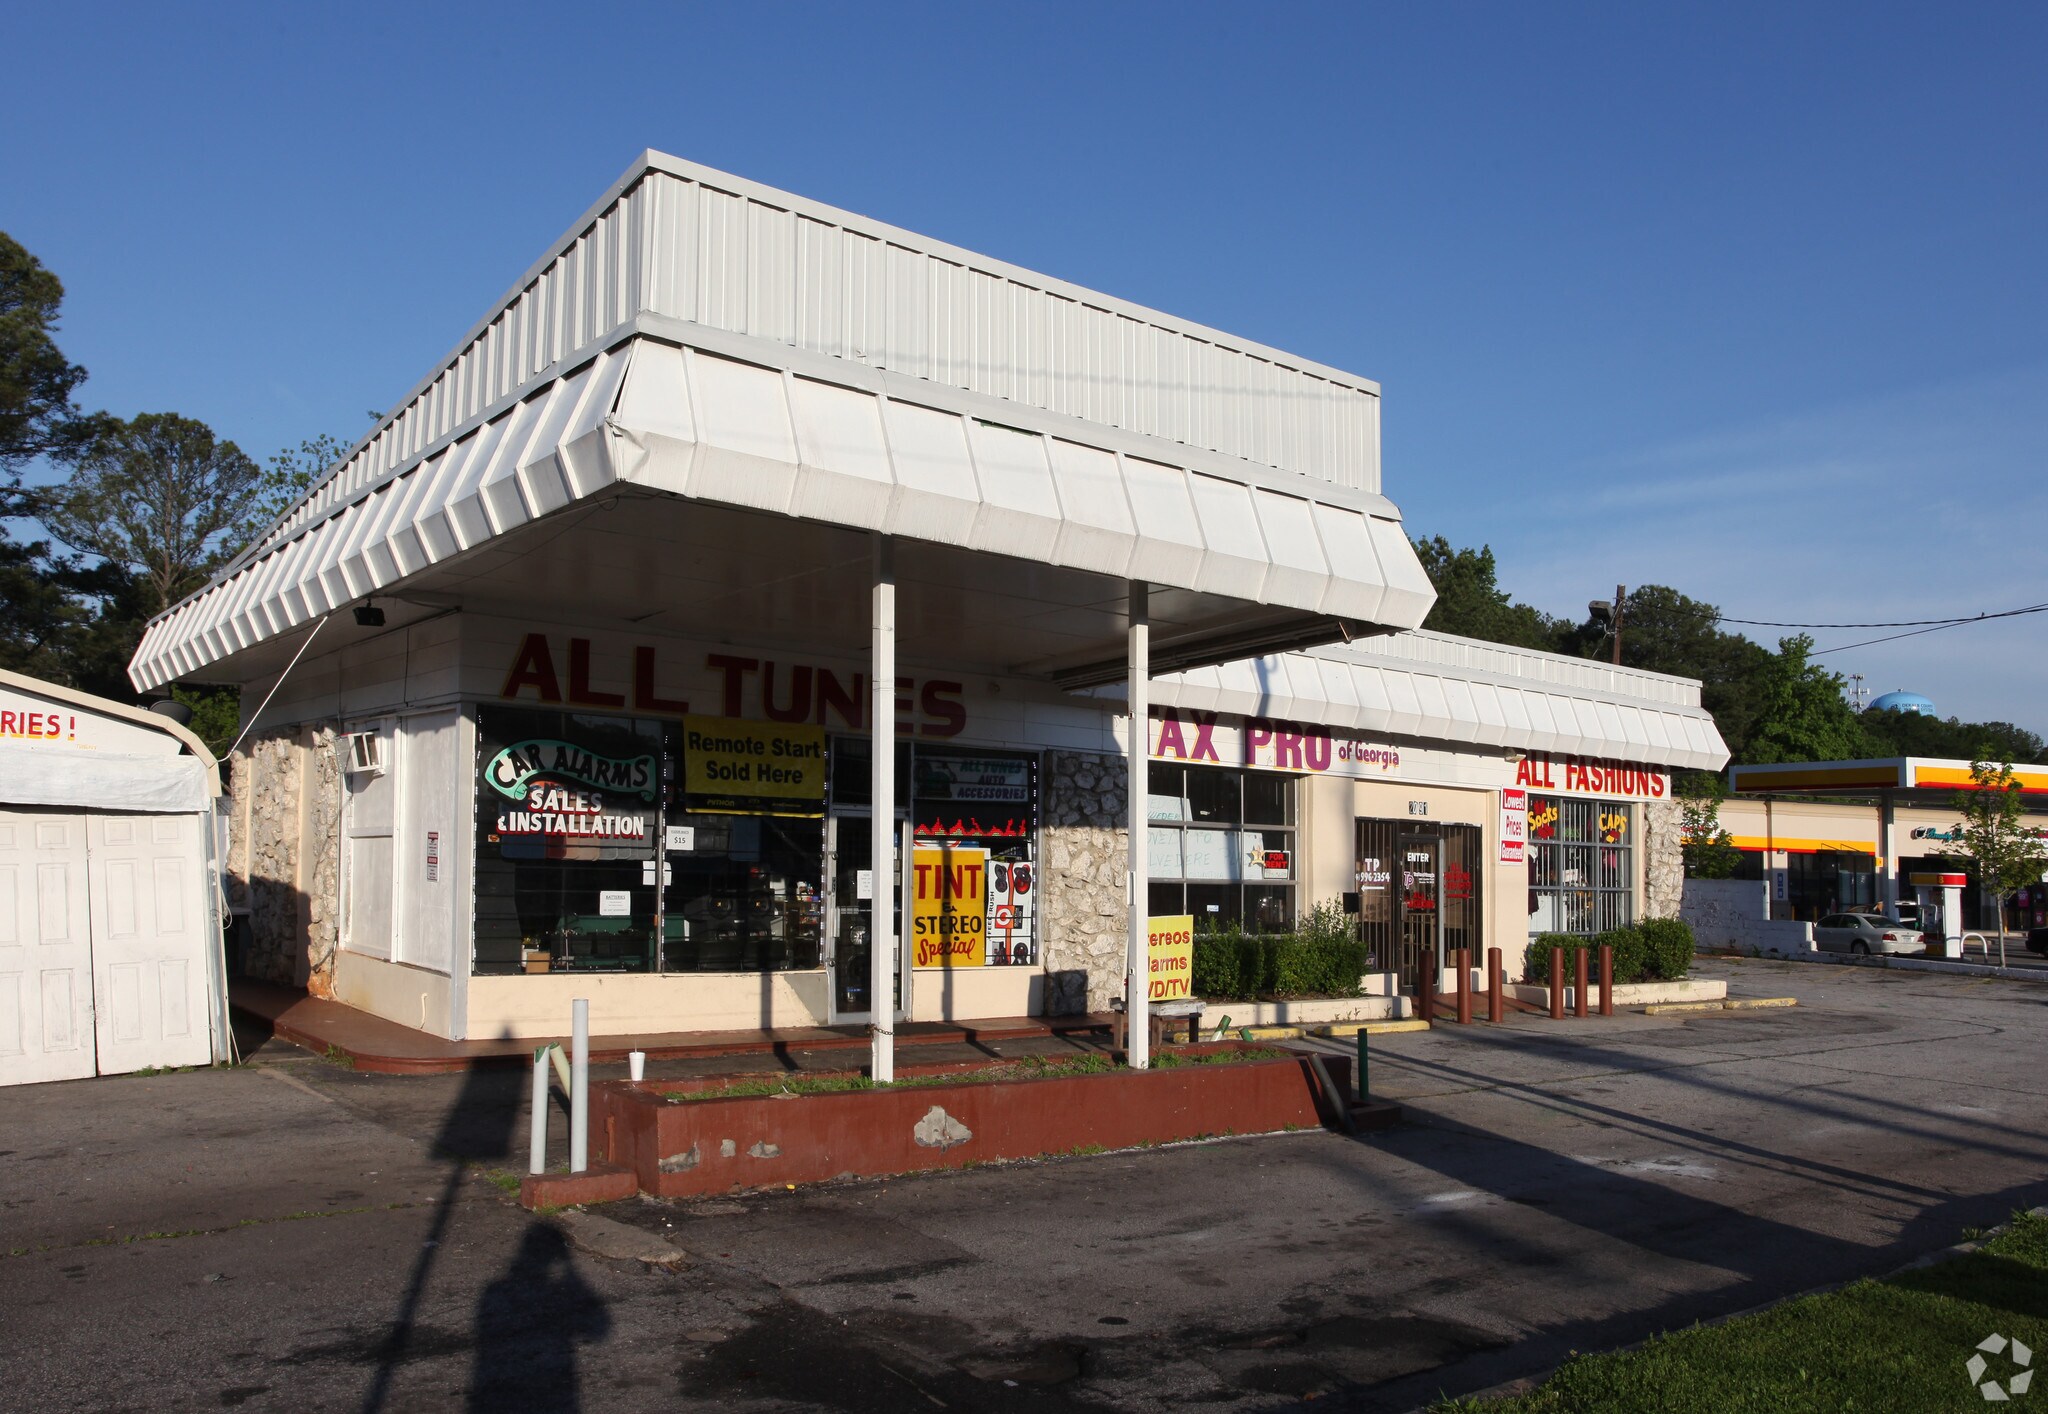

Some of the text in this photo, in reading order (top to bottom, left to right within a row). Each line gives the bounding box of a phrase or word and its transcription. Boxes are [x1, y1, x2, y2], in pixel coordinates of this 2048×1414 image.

[502, 632, 967, 739] ALL TUNES
[688, 731, 821, 759] Remote Start
[1147, 704, 1400, 772] AX PRO of Georgia
[493, 743, 651, 789] CAR ALARMS
[706, 760, 803, 784] Sold Here
[1516, 750, 1665, 798] ALL FASHIONS
[529, 789, 603, 815] SALES
[957, 787, 1027, 799] ACCESSORIES
[1504, 791, 1525, 809] Lowest
[1506, 814, 1522, 836] Prices
[1599, 812, 1627, 833] CAPS
[673, 836, 686, 844] $15
[1265, 861, 1288, 869] RENT
[1269, 853, 1284, 861] FOR
[1407, 852, 1429, 862] ENTER
[913, 864, 982, 900] TINT
[914, 915, 982, 935] STEREO
[1147, 930, 1190, 947] ereos
[917, 935, 976, 966] Special
